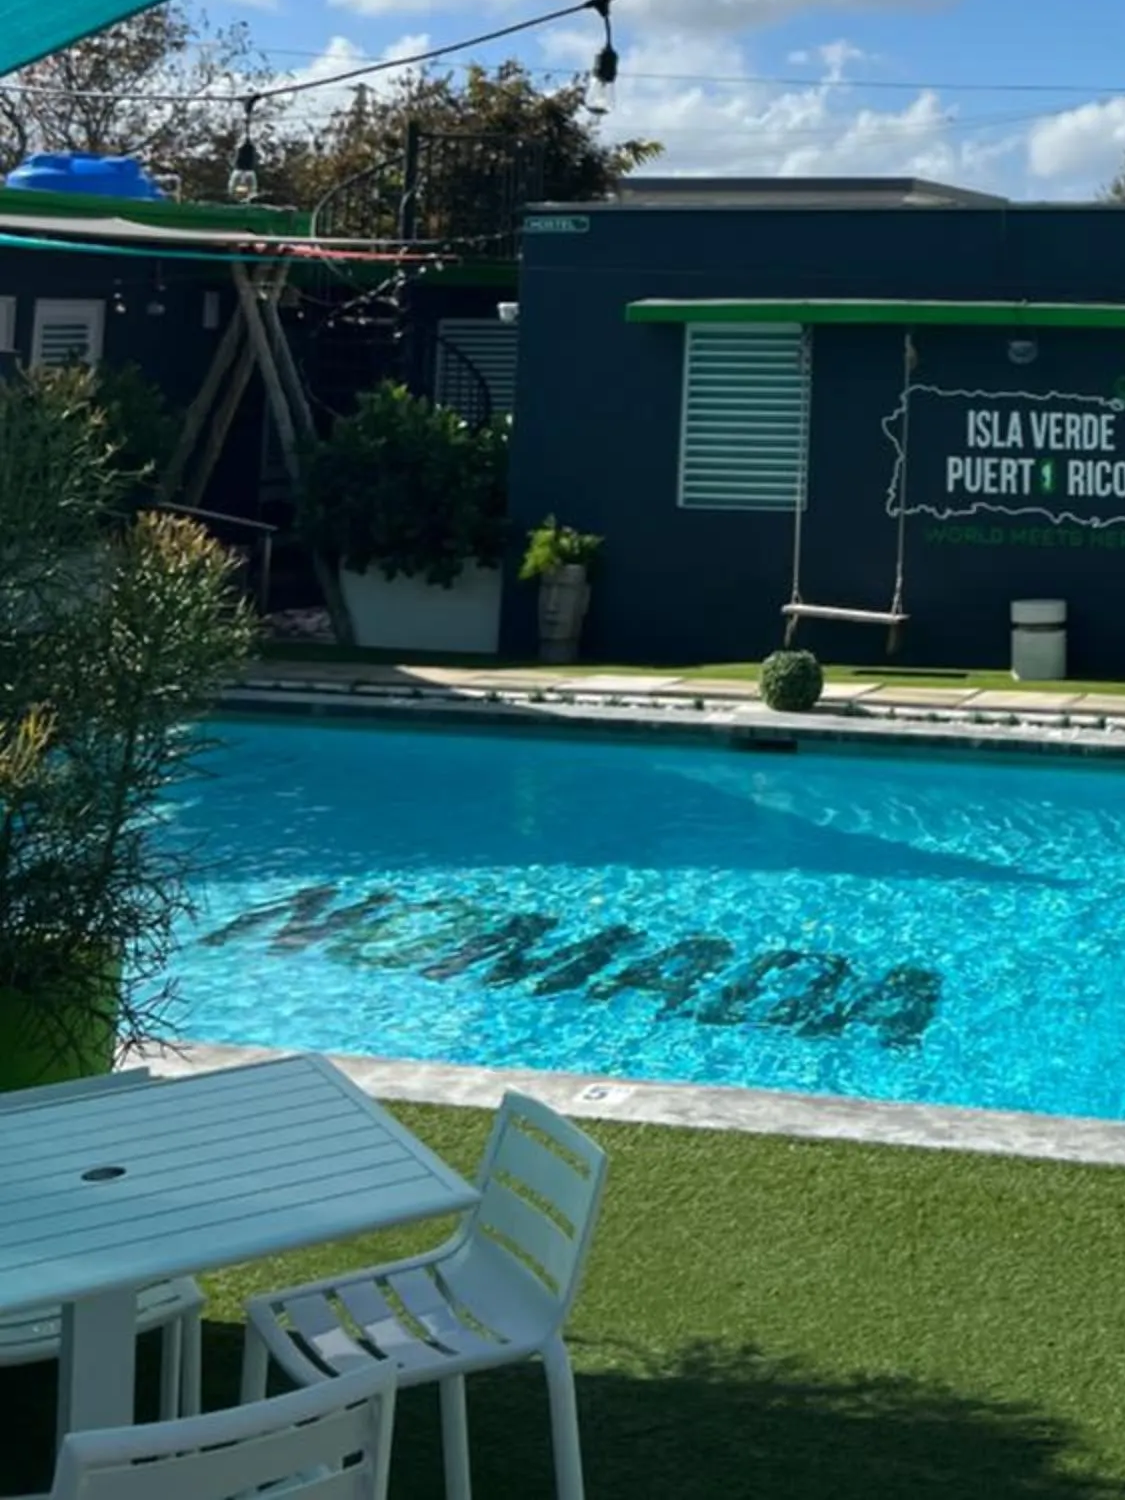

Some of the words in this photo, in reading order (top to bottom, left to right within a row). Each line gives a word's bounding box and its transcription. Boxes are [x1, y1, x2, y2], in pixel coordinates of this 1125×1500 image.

[966, 408, 1024, 449] ISLA
[1029, 411, 1117, 451] VERDE
[926, 525, 1005, 545] WORLD
[1010, 526, 1084, 548] MEETS
